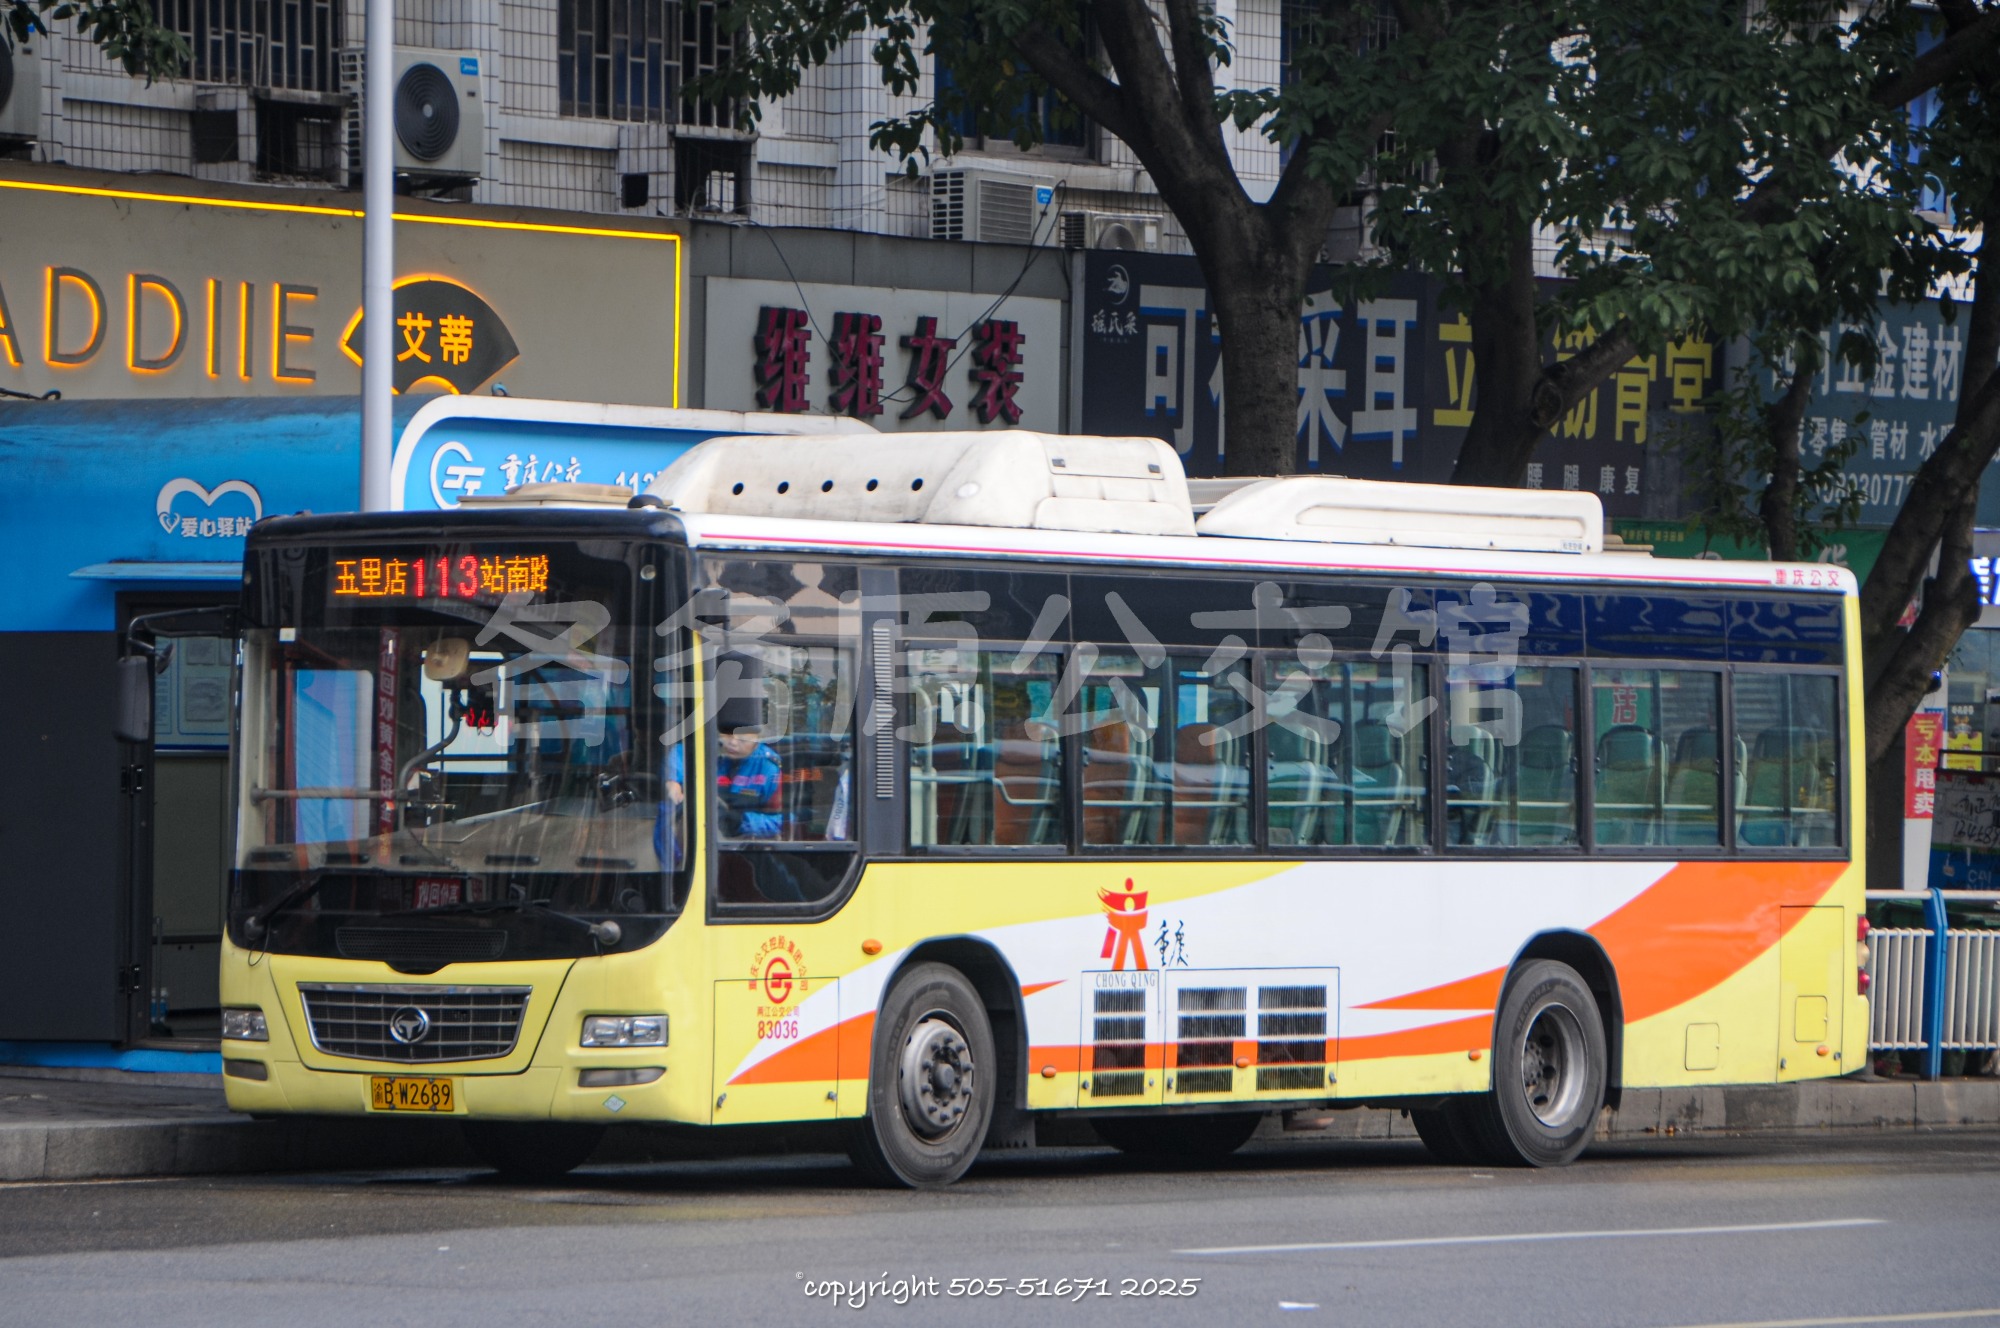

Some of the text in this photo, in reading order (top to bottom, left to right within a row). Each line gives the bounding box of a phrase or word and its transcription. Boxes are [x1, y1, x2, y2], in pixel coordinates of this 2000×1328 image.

[396, 311, 474, 366] 艾蒂
[753, 305, 1026, 425] 维维女装
[1139, 284, 1417, 470] 可采耳
[1870, 419, 1909, 460] 管材
[1600, 465, 1640, 495] 康复
[181, 516, 253, 538] 爱心驿站
[335, 554, 549, 597] 五里店 113 站南路
[1775, 568, 1839, 587] 重庆公交
[1913, 719, 1937, 815] 亏本甩卖
[1095, 972, 1156, 989] CHONG QING
[757, 1020, 799, 1039] 83036
